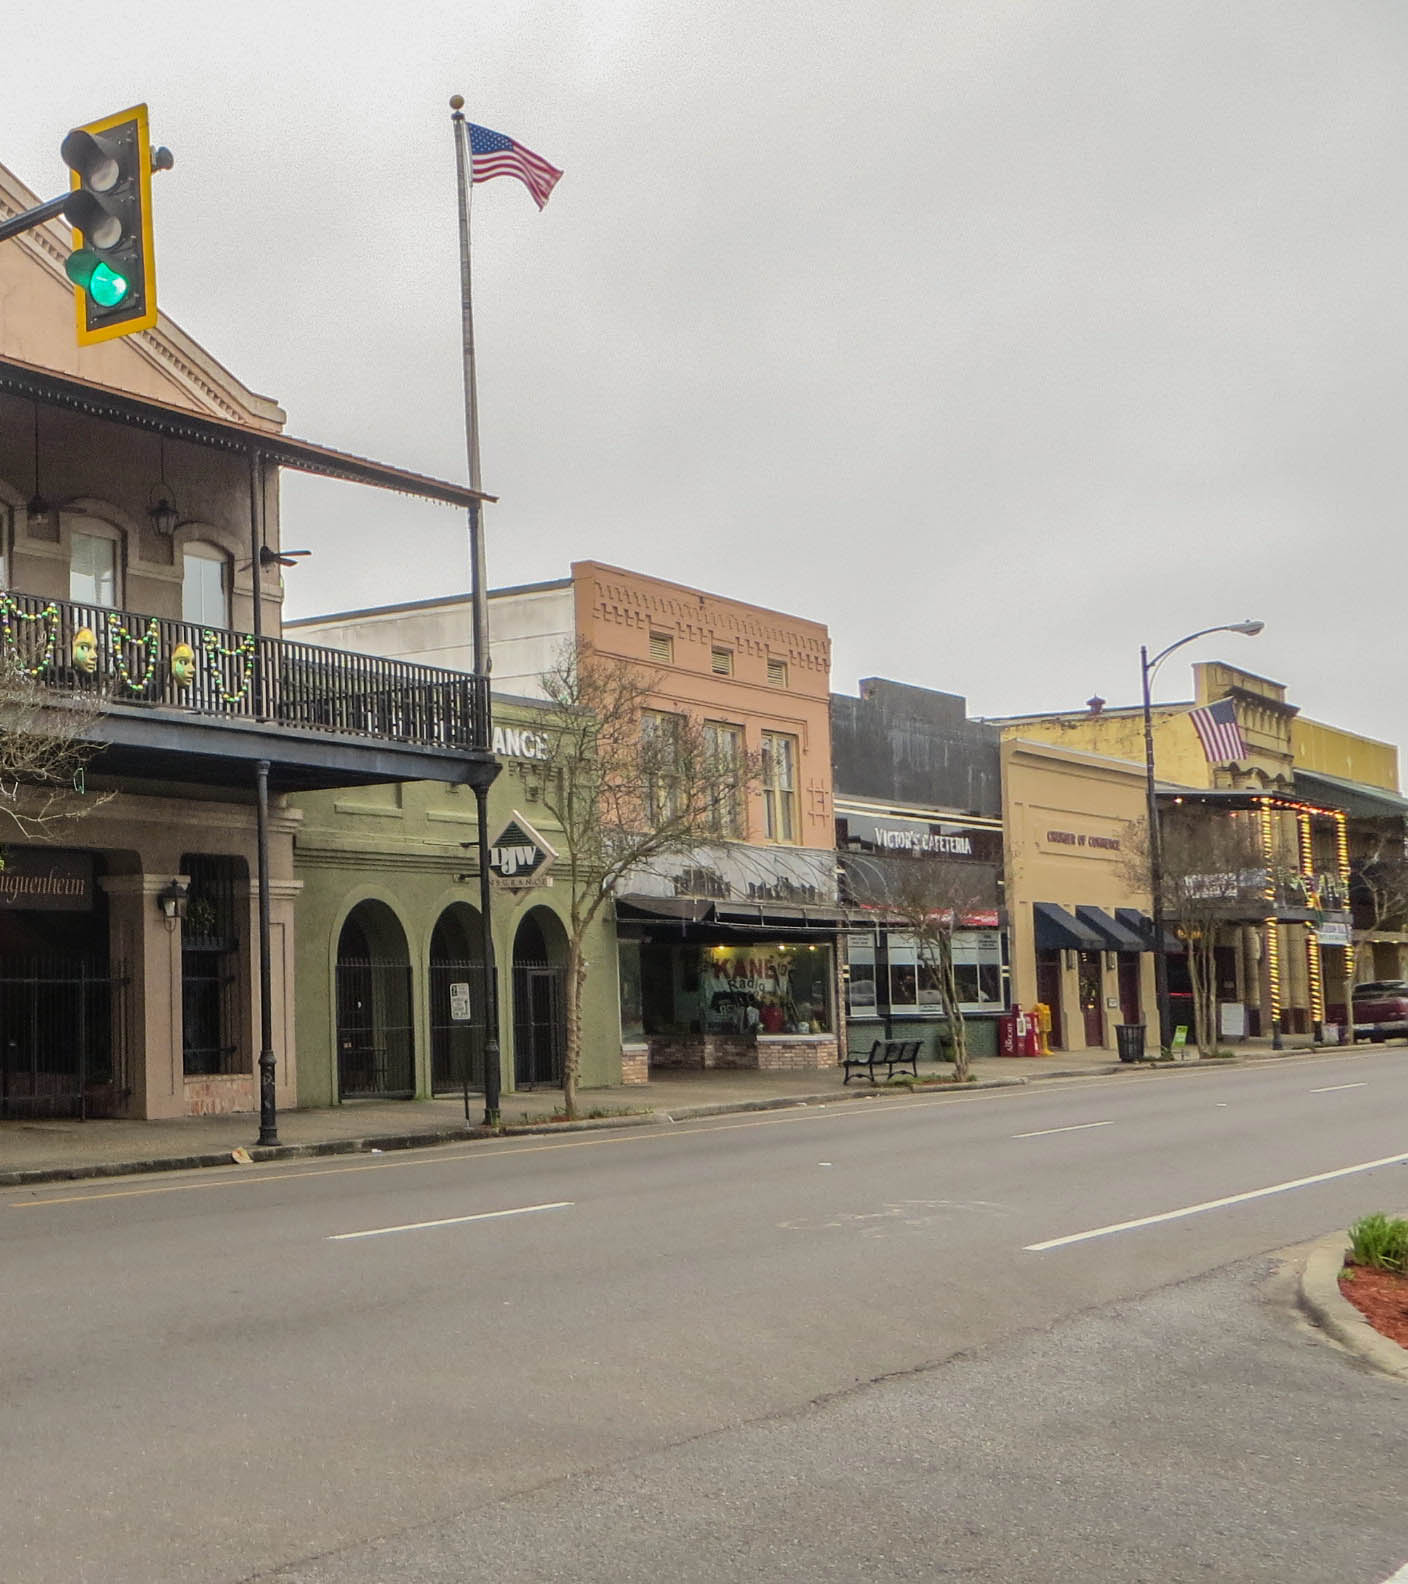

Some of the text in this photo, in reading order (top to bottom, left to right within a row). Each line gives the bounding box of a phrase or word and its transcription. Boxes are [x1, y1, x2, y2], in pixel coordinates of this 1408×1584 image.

[922, 833, 972, 854] CAFETERIA
[1078, 834, 1087, 846] OF
[1088, 836, 1120, 851] COMMERCE
